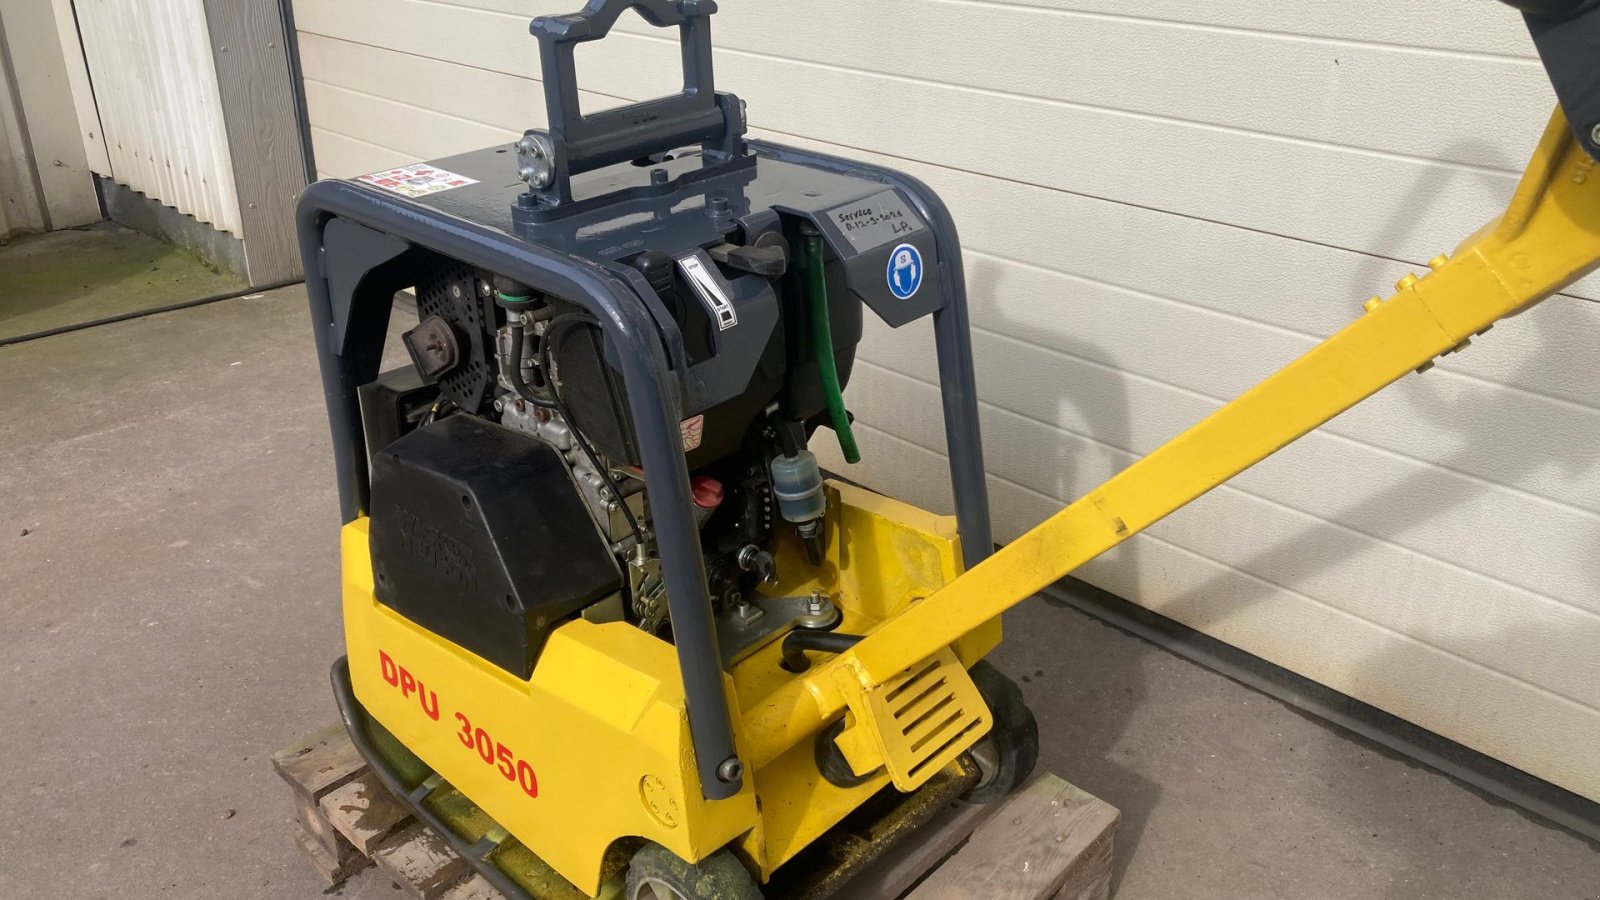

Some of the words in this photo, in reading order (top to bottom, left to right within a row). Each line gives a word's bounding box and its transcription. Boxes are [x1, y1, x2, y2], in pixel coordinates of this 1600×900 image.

[838, 208, 872, 223] Service
[900, 254, 907, 264] S
[717, 304, 729, 312] START
[379, 649, 440, 722] DPU
[454, 711, 538, 799] 3050
